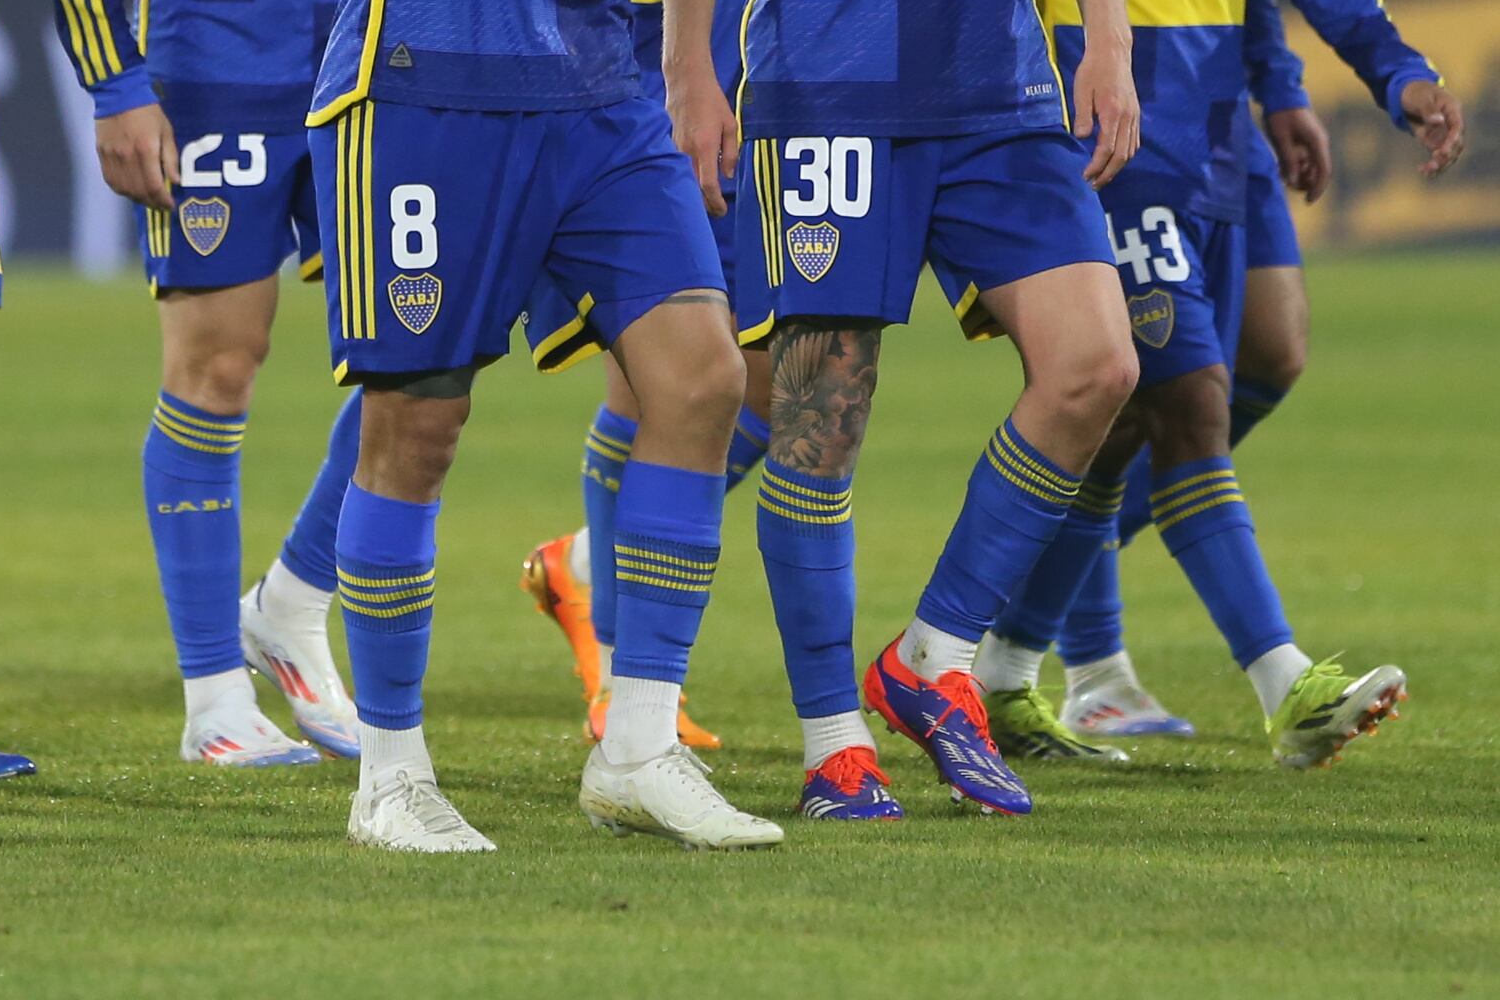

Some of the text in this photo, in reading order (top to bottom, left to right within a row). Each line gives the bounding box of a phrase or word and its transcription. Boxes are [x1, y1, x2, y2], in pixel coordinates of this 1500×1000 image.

[180, 133, 267, 187] 23
[784, 136, 873, 218] 30
[390, 184, 438, 270] 8
[794, 242, 832, 255] CABJ
[1105, 206, 1191, 285] 43
[396, 293, 436, 307] CABJ
